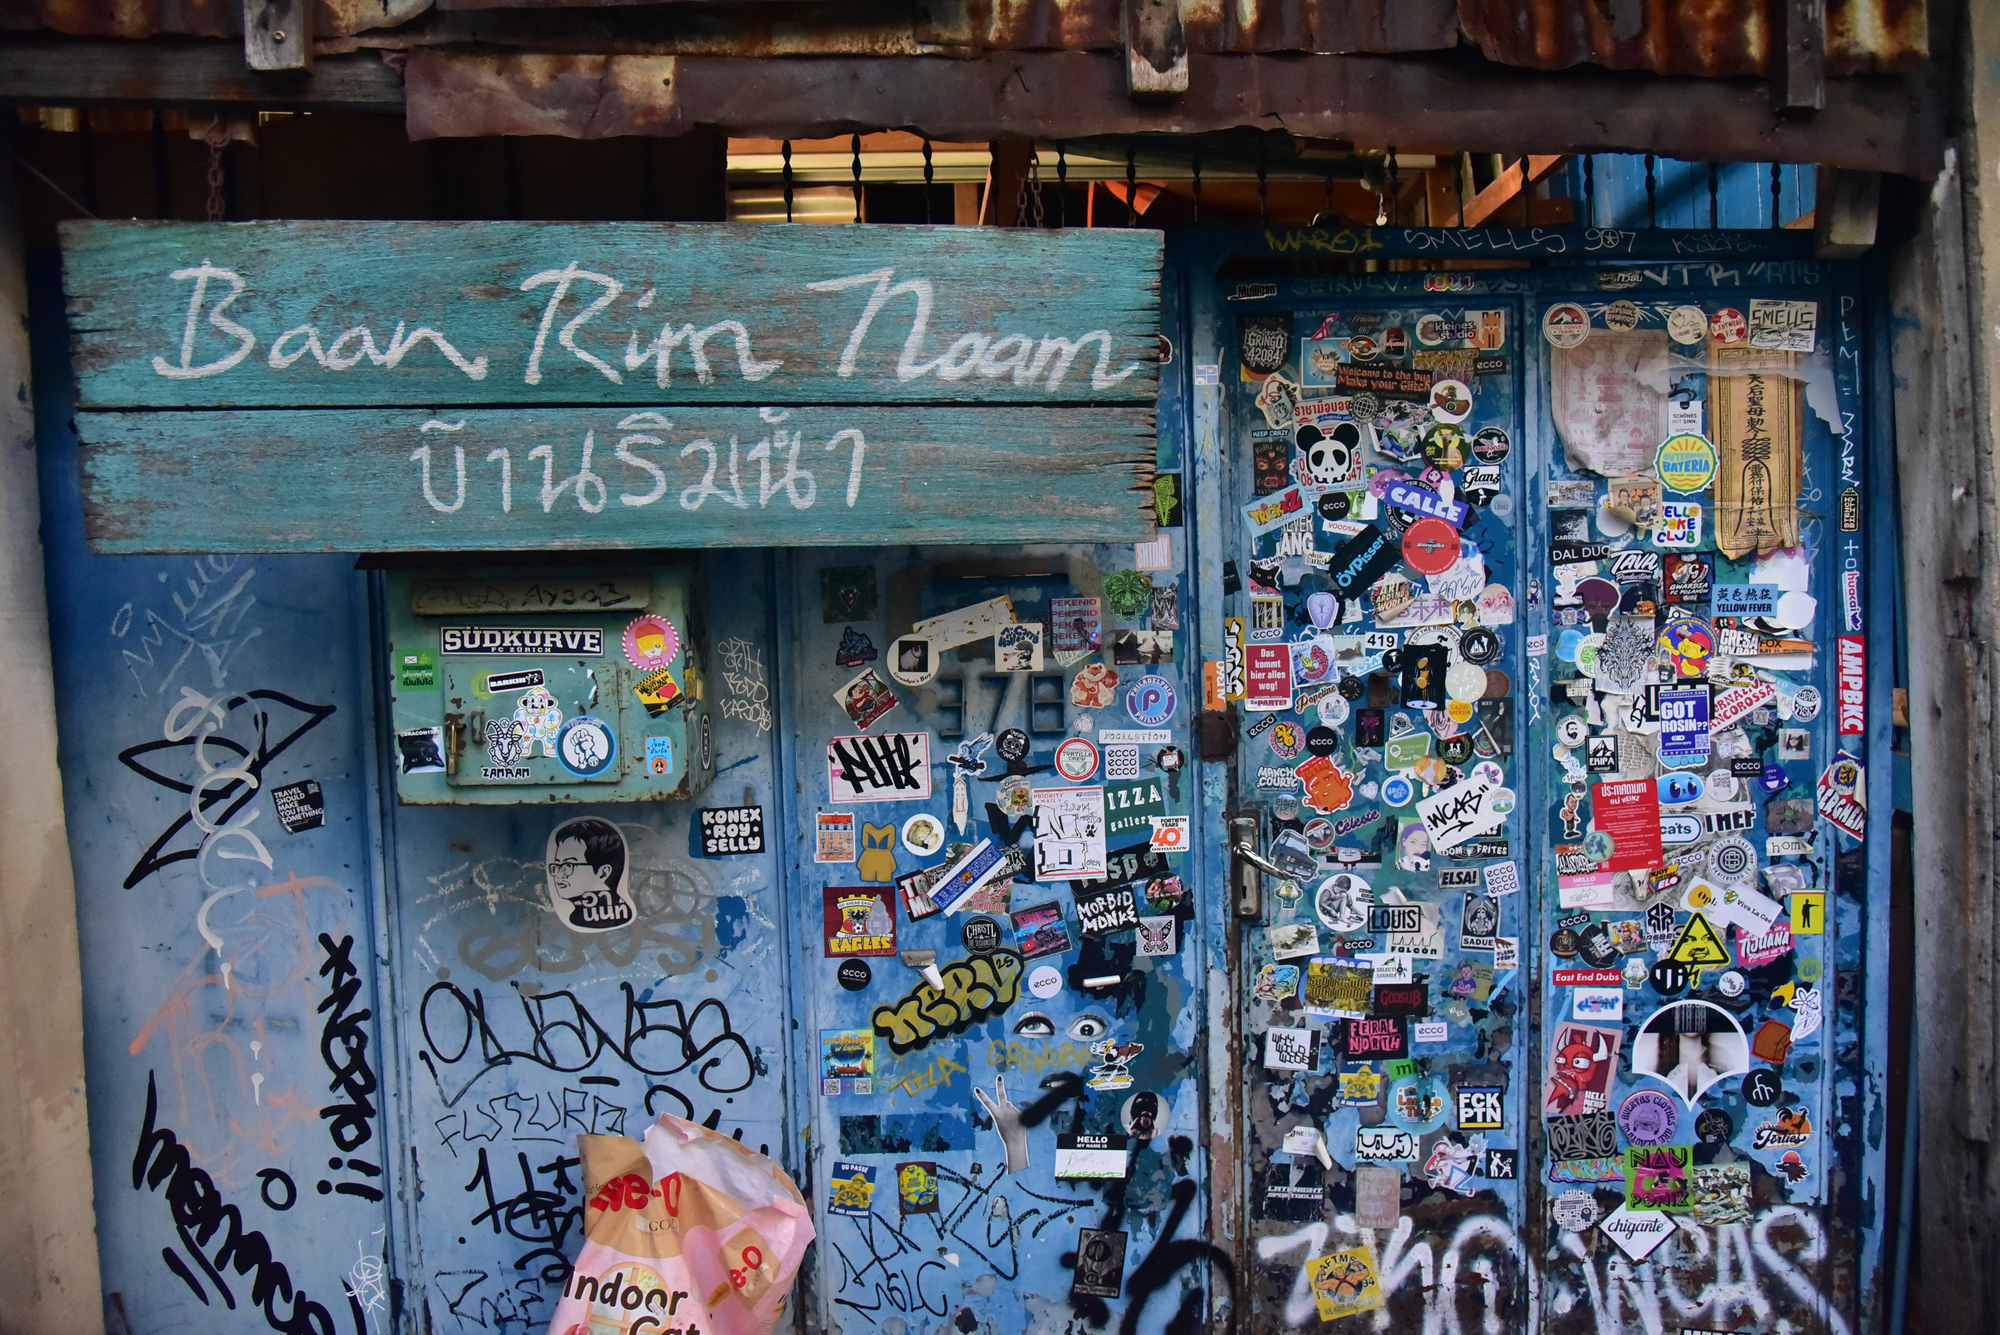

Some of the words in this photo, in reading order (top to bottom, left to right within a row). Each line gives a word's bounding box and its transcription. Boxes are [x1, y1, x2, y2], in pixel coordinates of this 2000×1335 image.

[152, 259, 488, 380] Baan
[519, 261, 783, 389] Rim
[1439, 331, 1475, 340] studio
[1248, 349, 1281, 363] 42084
[1477, 361, 1503, 369] ecco
[1337, 366, 1380, 378] Welcome
[1395, 370, 1411, 380] the
[1337, 375, 1367, 388] Make
[1370, 380, 1397, 390] your
[1662, 459, 1710, 473] BATERIA
[1463, 468, 1499, 489] Glanz
[1323, 501, 1345, 510] ecco
[1657, 531, 1695, 543] CLUB
[1336, 534, 1385, 588] ÖVPisser
[1553, 549, 1578, 561] DAL
[1610, 550, 1659, 574] TAVA
[1616, 573, 1651, 581] Production
[1847, 571, 1860, 611] huakai
[1717, 604, 1747, 612] YELLOW
[1749, 603, 1772, 612] FEVER
[444, 626, 600, 652] SÜDKURVE
[1253, 629, 1280, 639] ecco
[1367, 634, 1395, 648] 419
[1720, 628, 1760, 649] CRESA
[1760, 640, 1782, 648] FOX
[1261, 648, 1275, 657] Das
[1255, 660, 1281, 668] kommt
[403, 677, 434, 686] เป็นไปได้
[893, 672, 919, 684] Grandpa's
[919, 672, 932, 682] Boy
[1251, 671, 1266, 679] hier
[1268, 670, 1286, 679] alles
[1130, 677, 1173, 697] PHILADELPHIA
[1258, 681, 1278, 691] weg!
[1842, 638, 1864, 733] AMPBKC
[1296, 685, 1336, 713] Popeline
[1661, 701, 1696, 719] GOT
[1135, 711, 1168, 724] PHILLIES
[1249, 716, 1275, 736] ecco
[1662, 719, 1707, 733] ROSIN??
[1310, 738, 1333, 746] ecco
[1108, 749, 1137, 757] ecco
[1108, 758, 1137, 766] ecco
[1589, 757, 1615, 765] EKIPA
[1734, 762, 1760, 770] ecco
[483, 767, 530, 779] ZAMRAM
[1108, 768, 1137, 776] ecco
[274, 787, 301, 799] TRAVEL
[276, 793, 305, 805] SHOULD
[1107, 784, 1162, 810] IZZA
[277, 801, 299, 812] MAKE
[280, 808, 297, 818] YOU
[297, 804, 313, 814] FEEL
[281, 808, 324, 823] SOMETHING
[702, 809, 761, 824] KONEX
[1335, 810, 1380, 835] Céleste
[1110, 815, 1153, 832] gallery
[1661, 823, 1691, 834] cats
[713, 824, 751, 839] ROY
[706, 837, 761, 853] SELLY
[1477, 845, 1507, 855] FRITES
[1714, 839, 1731, 853] SOUTH
[1733, 839, 1752, 853] COAST
[1674, 854, 1702, 865] ecco
[1441, 871, 1477, 885] ELSA!
[1486, 865, 1514, 877] ecco
[1712, 866, 1744, 881] SKATEBOARD
[1488, 874, 1515, 885] ecco
[1490, 882, 1517, 893] ecco
[1077, 891, 1133, 920] MORBID
[1737, 900, 1752, 911] Viva
[1752, 908, 1760, 917] La
[1760, 913, 1772, 924] Cao
[1371, 909, 1417, 929] LOUIS
[1560, 915, 1588, 927] ecco
[966, 924, 996, 938] CHRISTL
[830, 936, 891, 952] EAGLES
[1344, 941, 1372, 949] ecco
[1739, 931, 1789, 957] TIJUANA
[842, 968, 866, 978] ecco
[1576, 973, 1594, 981] End
[1596, 973, 1619, 981] Dubs
[1033, 977, 1057, 988] ecco
[1351, 1019, 1398, 1036] FERAL
[1419, 1026, 1444, 1034] ecco
[1349, 1034, 1400, 1054] NORTH
[1459, 1093, 1500, 1108] FCK
[1621, 1096, 1650, 1120] AVERTAS
[1653, 1096, 1675, 1126] CLOTHES
[1460, 1108, 1501, 1123] PTN
[1076, 1136, 1108, 1144] HELLO
[1658, 1128, 1673, 1143] ARE
[649, 1218, 677, 1232] GOLD
[1607, 1219, 1664, 1240] chigante
[564, 1266, 688, 1316] Indoor
